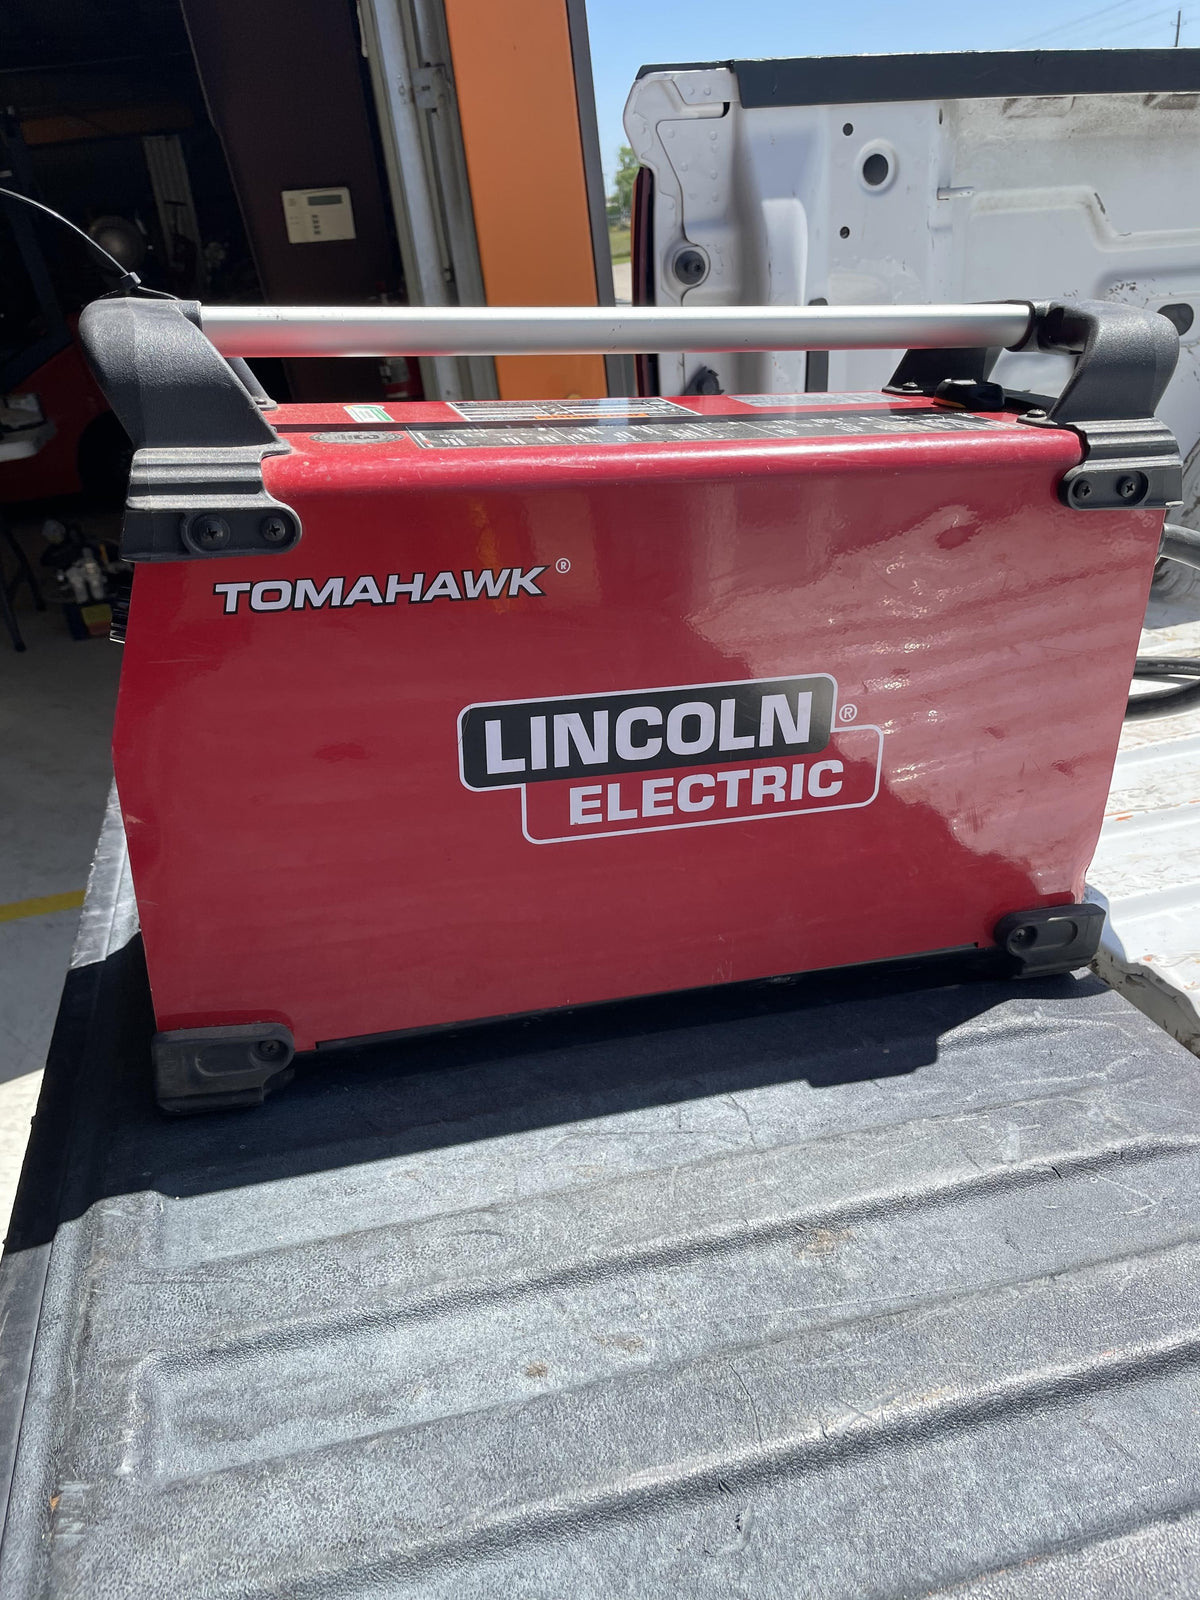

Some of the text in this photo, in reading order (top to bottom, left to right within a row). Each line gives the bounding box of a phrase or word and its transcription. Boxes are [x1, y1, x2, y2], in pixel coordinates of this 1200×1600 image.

[213, 564, 550, 615] TOMAHAWK
[485, 691, 813, 775] LINCOLN
[569, 759, 844, 826] ELECTRIC
